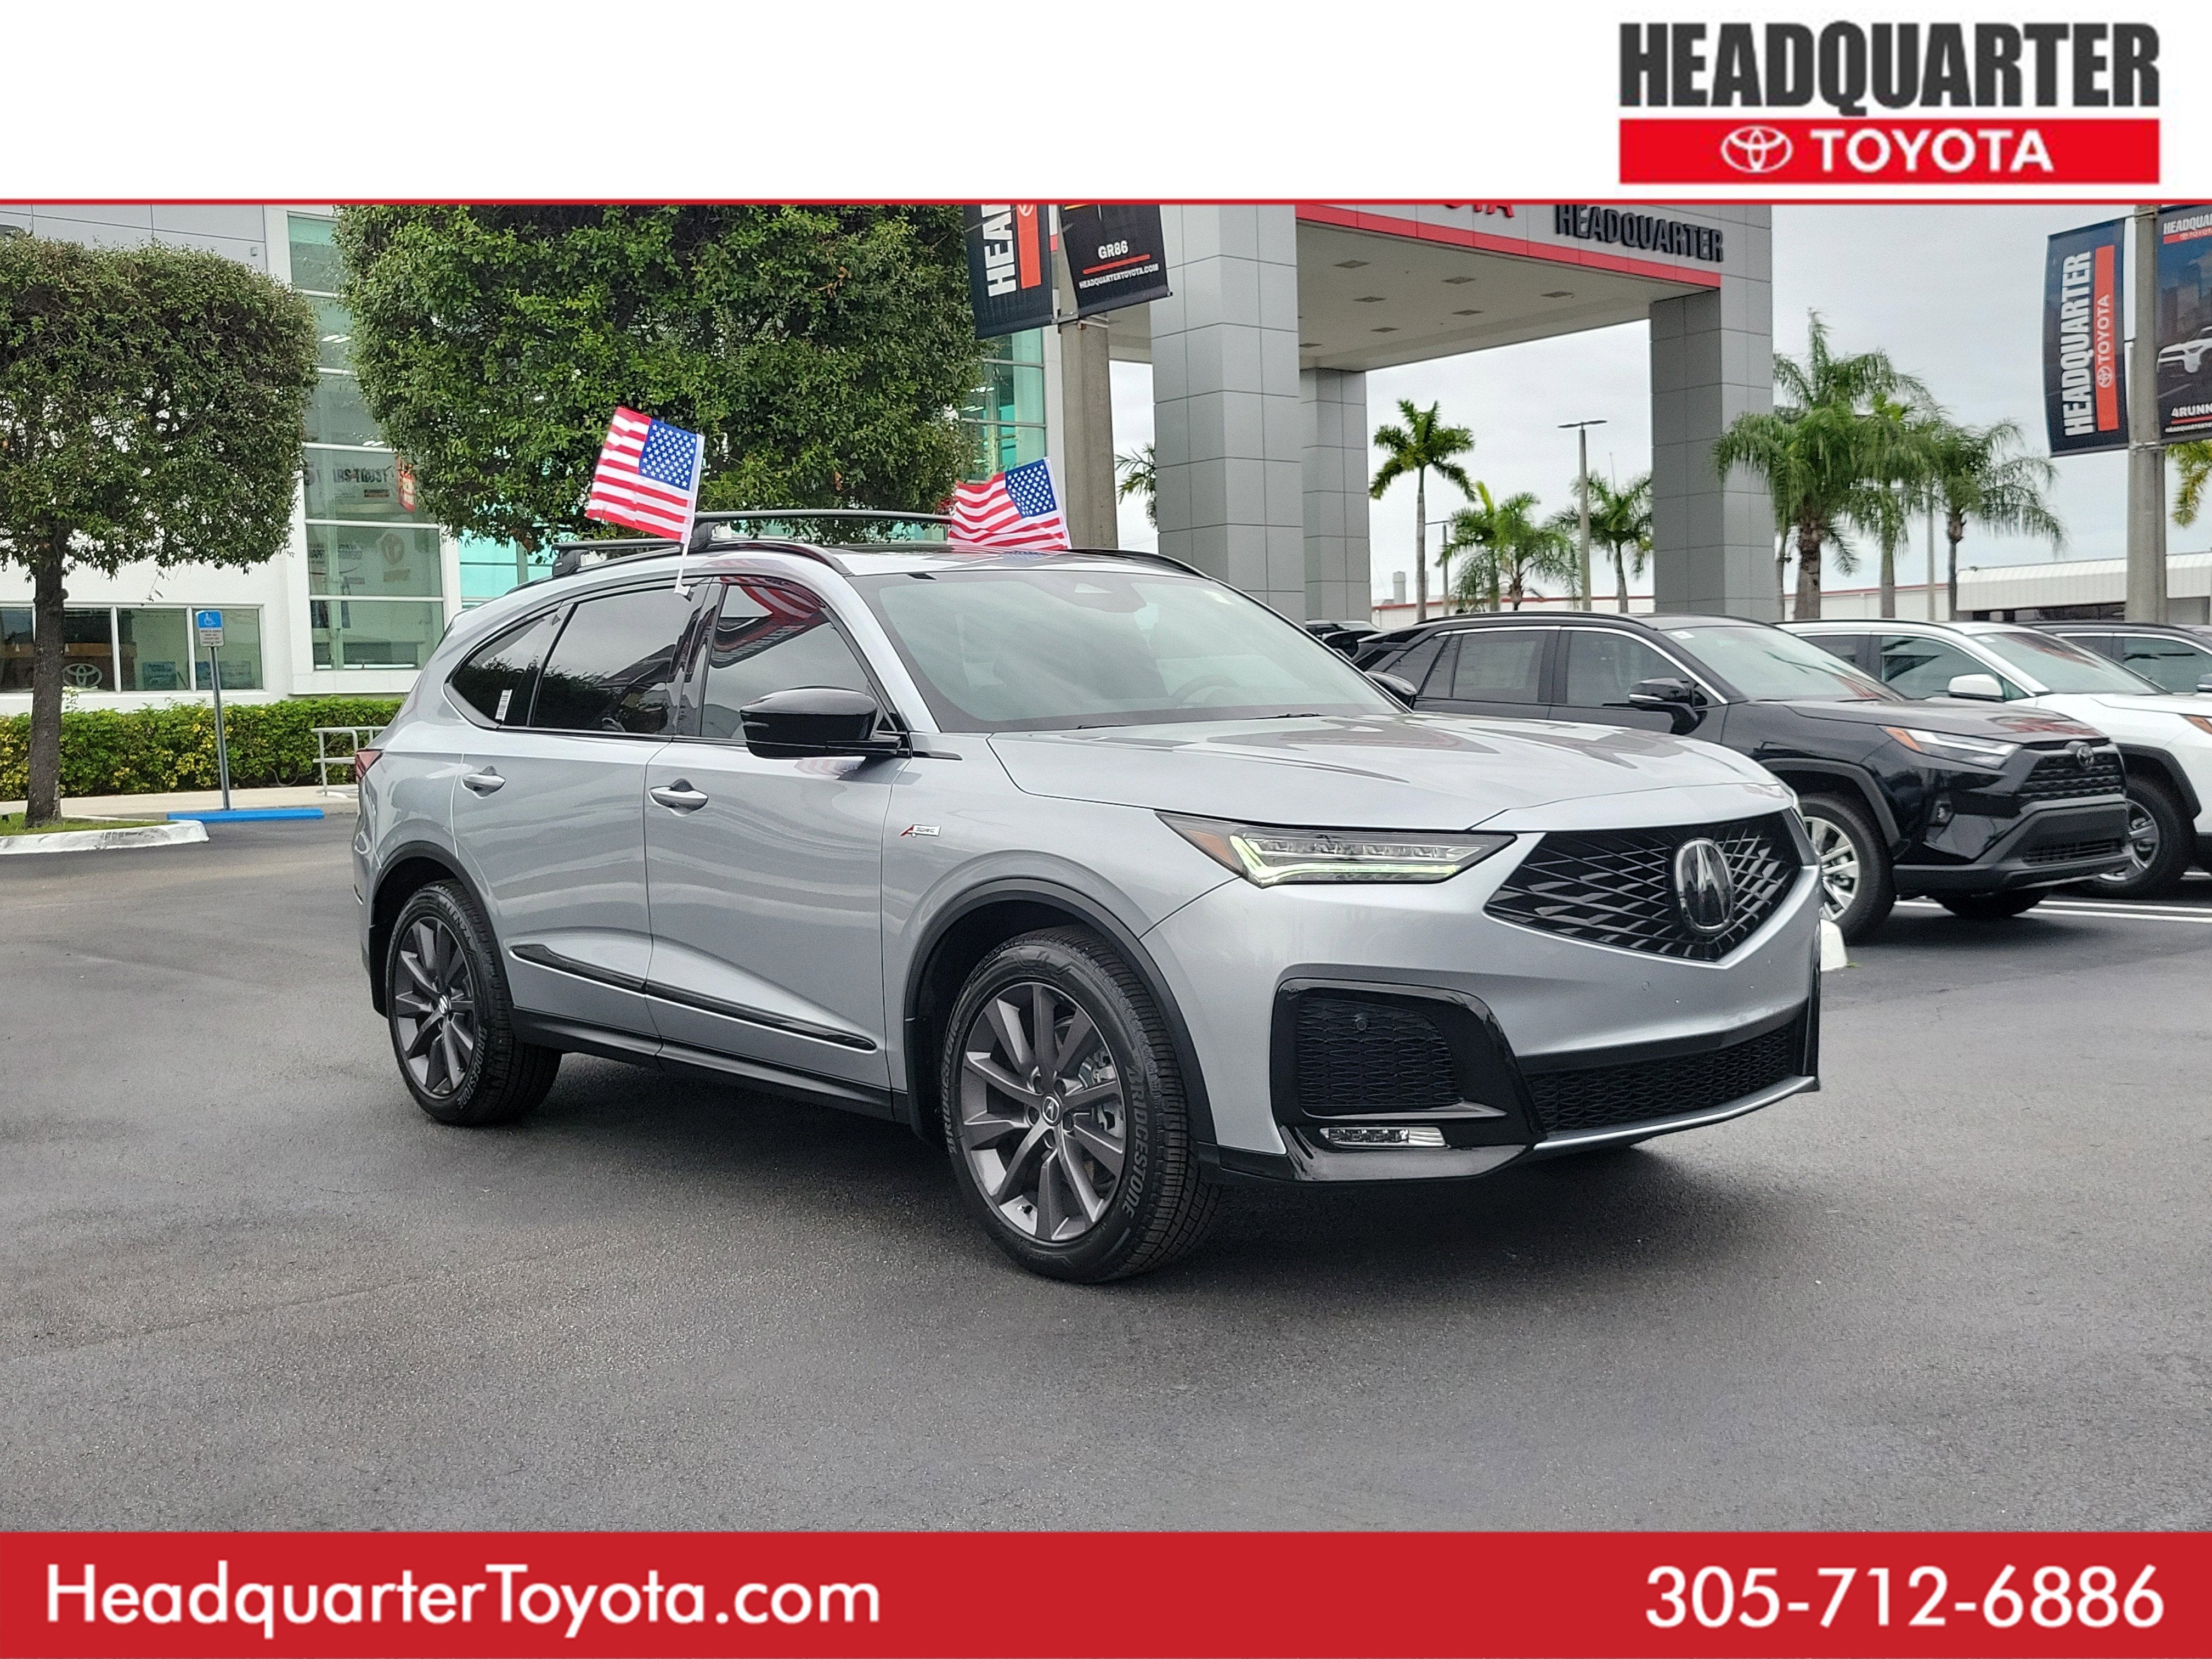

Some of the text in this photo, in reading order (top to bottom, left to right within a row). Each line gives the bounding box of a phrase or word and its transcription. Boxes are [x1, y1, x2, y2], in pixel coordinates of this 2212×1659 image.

[1098, 240, 1128, 259] GR86
[1554, 204, 1724, 262] HEADQUARTER
[1078, 263, 1160, 290] HEADQUARTERTOYOTA.COM
[2060, 251, 2095, 436] HEADQUARTER
[2097, 294, 2111, 364] TOYOTA
[1122, 1065, 1149, 1219] BRIDGESTONE
